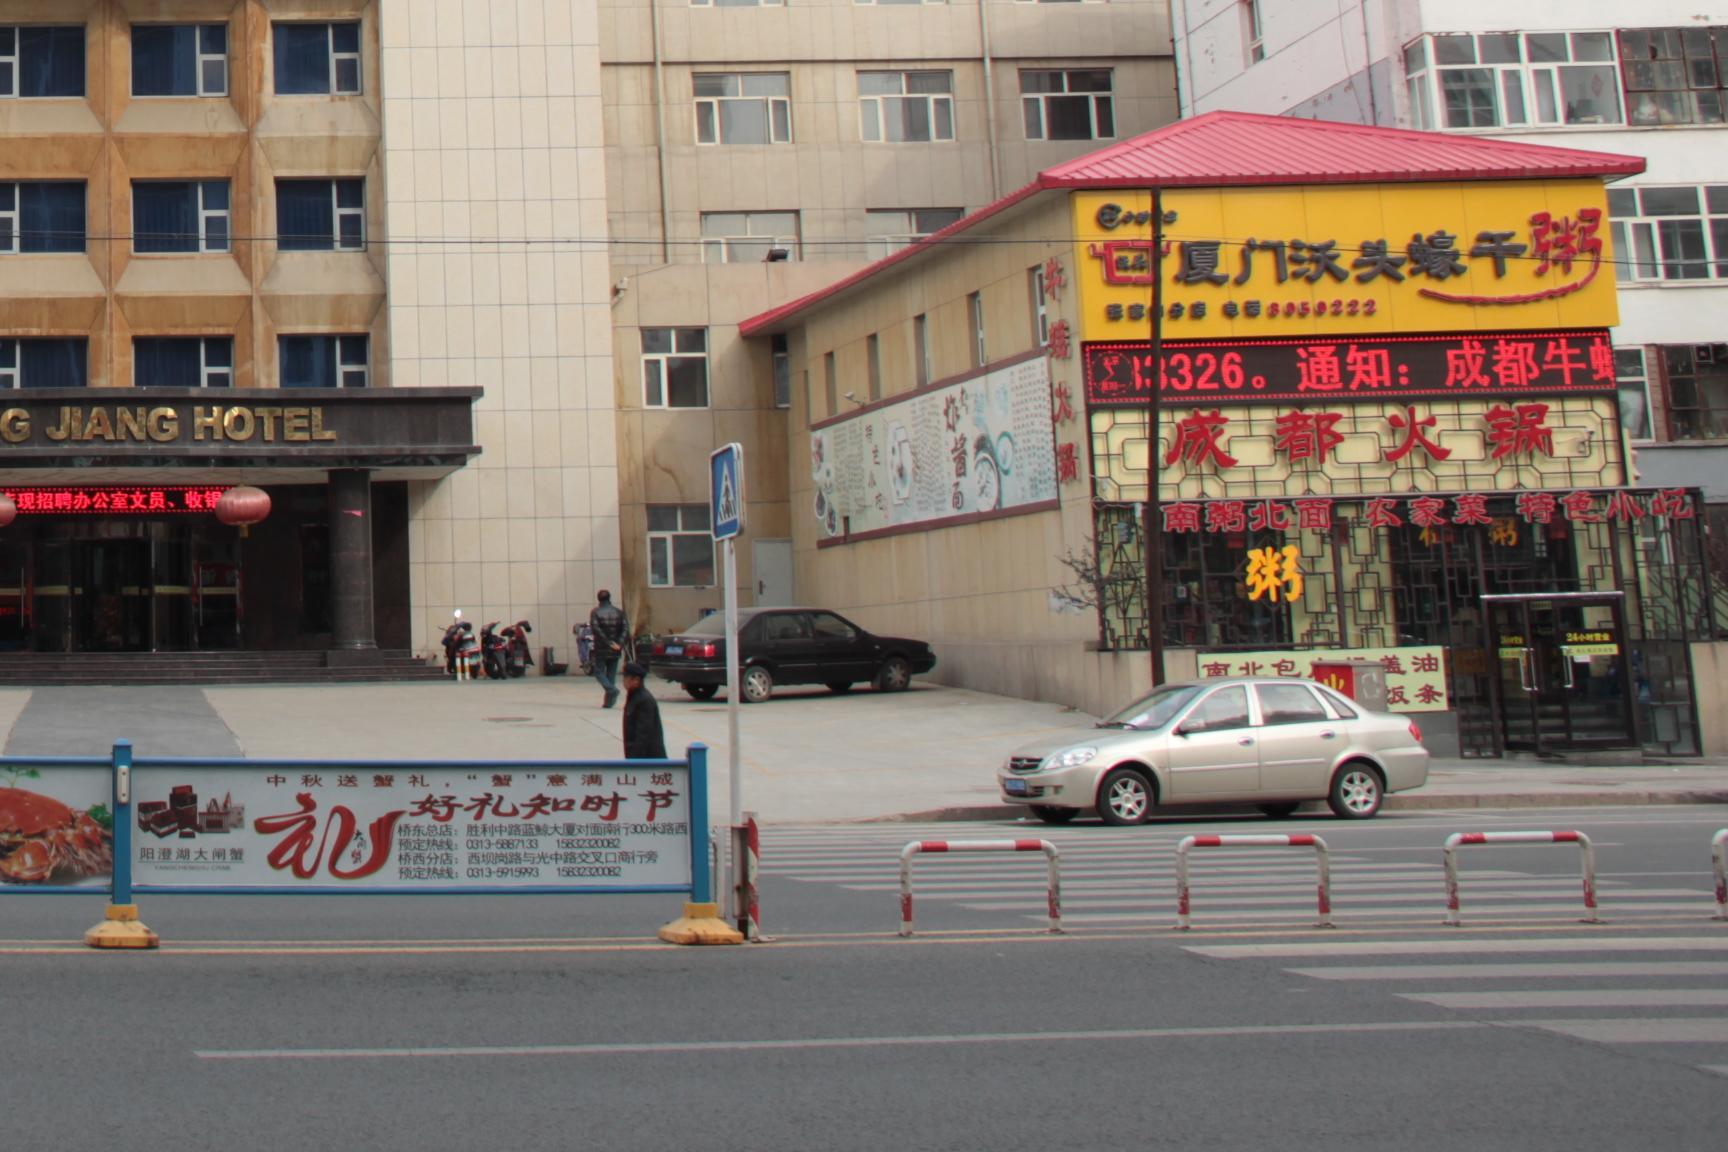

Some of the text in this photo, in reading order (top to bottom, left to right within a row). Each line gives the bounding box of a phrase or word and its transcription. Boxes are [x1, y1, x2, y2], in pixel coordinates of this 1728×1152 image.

[1106, 301, 1208, 323] 张家分店
[45, 404, 179, 443] JIANG
[192, 404, 337, 442] HOTEL
[1165, 401, 1556, 469] 成都火锅
[1160, 487, 1695, 534] 南粥北面 农家菜 特色小吃
[1245, 544, 1304, 603] 粥
[408, 789, 680, 823] 好礼知时节
[139, 847, 245, 861] 阳澄湖大闸蟹
